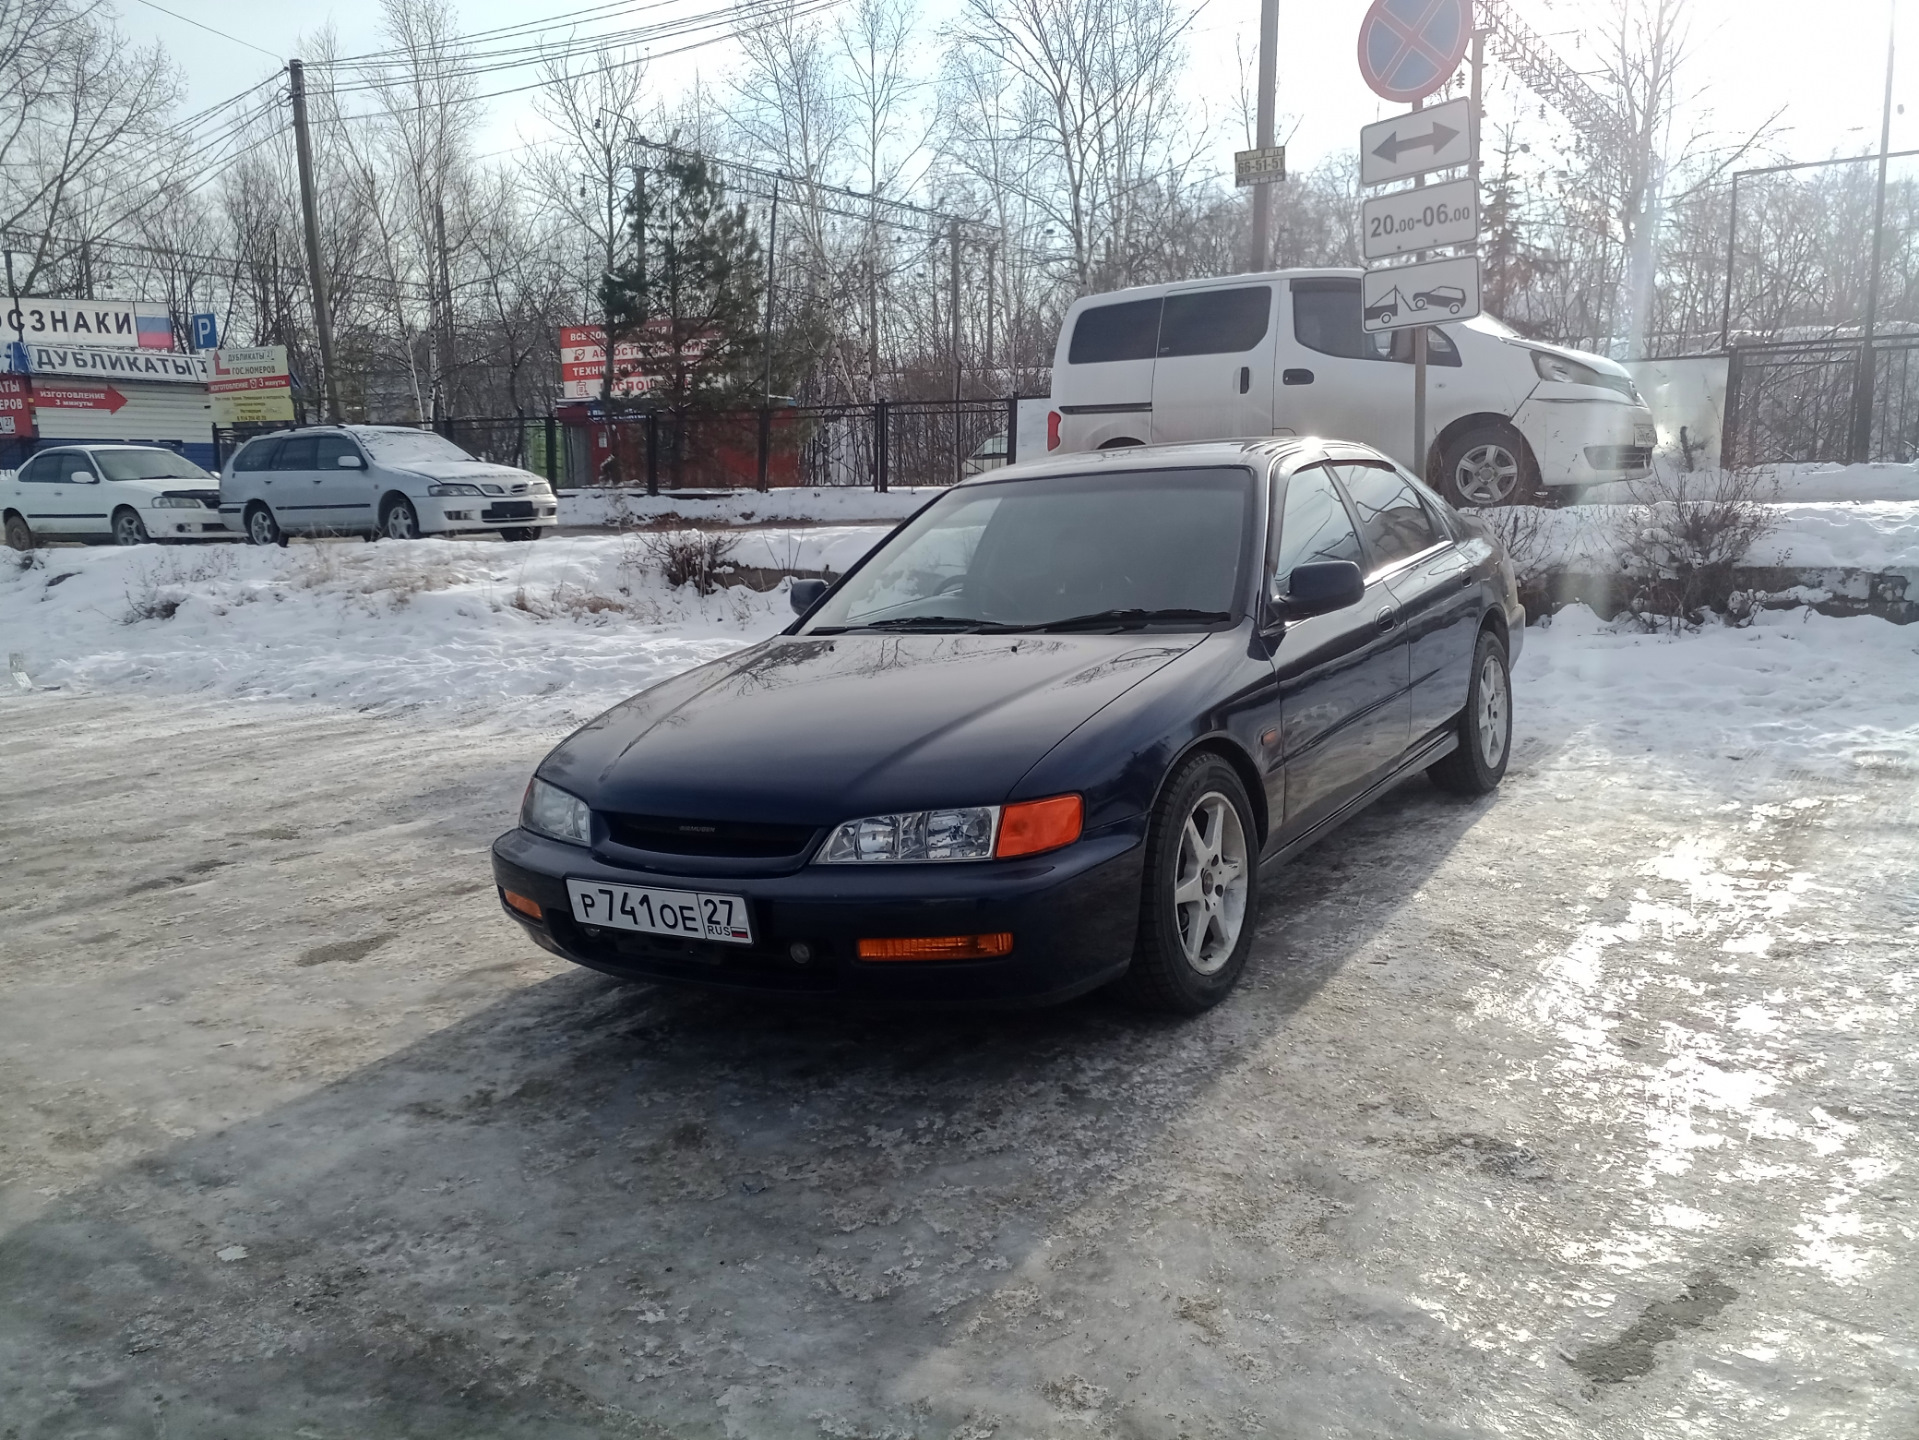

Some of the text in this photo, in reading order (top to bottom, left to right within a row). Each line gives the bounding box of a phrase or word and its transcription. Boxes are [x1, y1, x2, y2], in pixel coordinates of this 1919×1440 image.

[1237, 157, 1284, 174] 66-51-51
[1370, 203, 1470, 238] 20.00-06.00
[0, 309, 133, 335] СЗНАКИ
[197, 318, 211, 345] P
[36, 348, 193, 376] ДУБЛИКАТЫ
[228, 352, 265, 362] ДУБЛИКАТЫ
[210, 381, 249, 391] ИЗГОТОВЛЕНИЕ
[258, 377, 264, 387] 3
[40, 390, 106, 400] ИЗГОТОВЛЕНИЕ
[703, 898, 734, 926] 27
[707, 925, 731, 937] RUS
